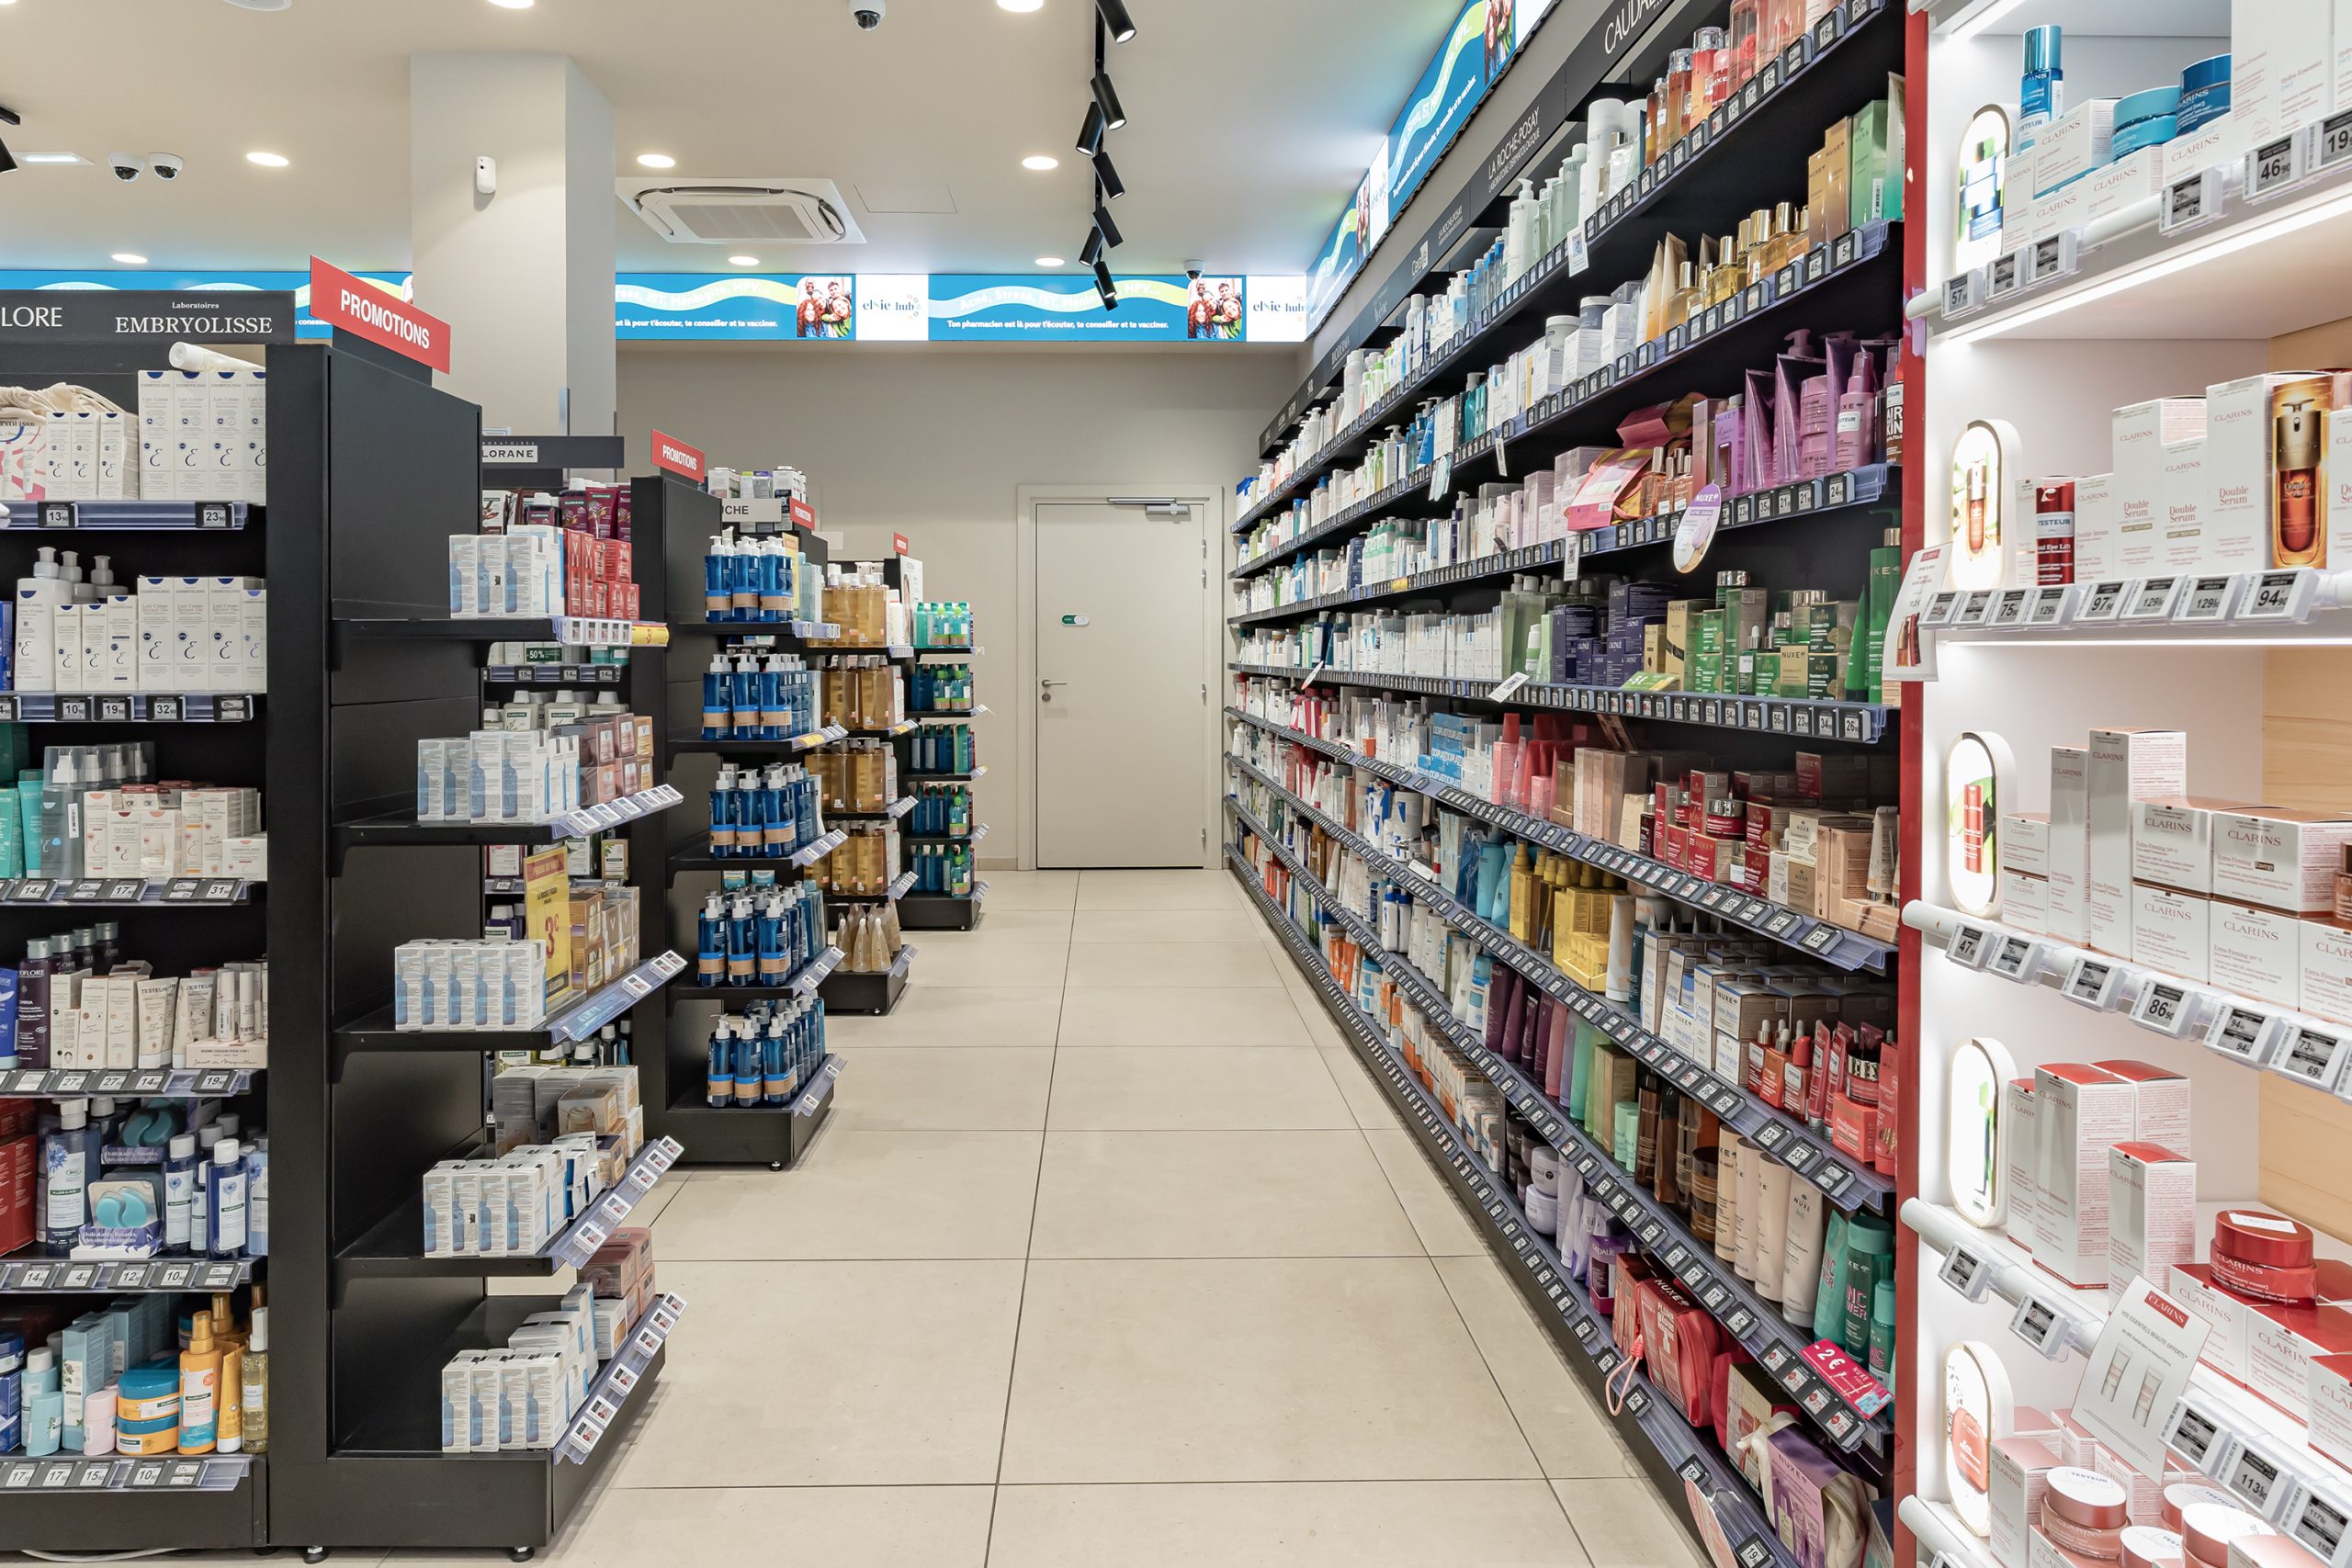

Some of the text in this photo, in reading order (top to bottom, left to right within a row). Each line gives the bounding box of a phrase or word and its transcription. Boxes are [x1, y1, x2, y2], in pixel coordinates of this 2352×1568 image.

[2041, 119, 2081, 146] CLARINS
[1488, 106, 1540, 180] LA ROCHE-POSAY
[1826, 143, 1841, 157] NUXE
[2171, 133, 2221, 163] CLARINS
[2005, 166, 2031, 183] CLARINS
[2093, 165, 2138, 193] CLARINS
[2035, 195, 2077, 219] CLARINS
[172, 301, 220, 310] Laboratoires
[896, 301, 915, 310] hub
[115, 317, 273, 333] EMBRYOLISSE
[340, 288, 430, 349] PROMOTIONS
[632, 321, 649, 330] pour
[684, 320, 693, 328] te
[694, 319, 728, 328] conseiller
[729, 320, 737, 328] et
[738, 320, 746, 328] te
[747, 319, 778, 328] vacciner.
[947, 320, 961, 329] Ton
[962, 320, 1003, 331] pharmacien
[1004, 321, 1016, 329] est
[1017, 320, 1023, 329] là
[1024, 321, 1042, 331] pour
[1076, 321, 1084, 329] te
[1085, 320, 1119, 329] conseiller
[1120, 321, 1128, 329] et
[1129, 321, 1137, 329] te
[1138, 320, 1170, 329] vacciner.
[1886, 407, 1903, 421] AIR
[2214, 409, 2254, 423] CLARINS
[2120, 431, 2154, 442] CLARINS
[482, 449, 534, 458] LORANE
[662, 444, 697, 471] PROMOTIONS
[2165, 460, 2201, 473] CLARINS
[2219, 485, 2249, 499] Double
[2283, 481, 2312, 491] Double
[1694, 493, 1713, 502] NUXE
[2077, 491, 2109, 502] CLARINS
[2284, 489, 2311, 498] Serum
[2123, 500, 2150, 511] Double
[2220, 496, 2248, 507] Serum
[722, 505, 749, 515] CHE
[2124, 509, 2149, 519] Serum
[2169, 504, 2197, 516] Double
[2037, 517, 2071, 527] TESTEUR
[2169, 513, 2196, 524] Serum
[1782, 651, 1800, 660] NUXE
[2092, 750, 2125, 763] CLARINS
[2052, 767, 2083, 778] CLARINS
[2144, 817, 2193, 834] CLARINS
[2011, 829, 2035, 839] CLARINS
[2227, 829, 2282, 847] CLARINS
[2011, 885, 2035, 896] CLARINS
[2144, 902, 2192, 921] CLARINS
[2223, 920, 2279, 942] CLARINS
[2315, 941, 2352, 959] CLAR
[1694, 978, 1708, 989] NUXE
[141, 987, 168, 995] TESTEUR
[1717, 990, 1734, 1005] NUXE
[1674, 1013, 1689, 1026] NUXE
[2039, 1089, 2073, 1111] CLARINS
[2010, 1101, 2034, 1118] CLARI
[2109, 1168, 2143, 1192] CLARINS
[1793, 1197, 1811, 1213] NUXE
[2215, 1253, 2264, 1276] CLARINS
[1655, 1278, 1680, 1303] NUXE
[2147, 1293, 2186, 1325] CLARINS
[2178, 1287, 2233, 1325] CLARINS
[2129, 1314, 2151, 1335] ESSENTIELS
[2257, 1331, 2307, 1367] CLARIN
[1852, 1365, 1870, 1382] NUXE
[1991, 1461, 2022, 1490] CLARINS
[2071, 1471, 2109, 1484] TESTEUR
[2056, 1517, 2102, 1539] CLARINS
[2163, 1535, 2182, 1550] TEST
